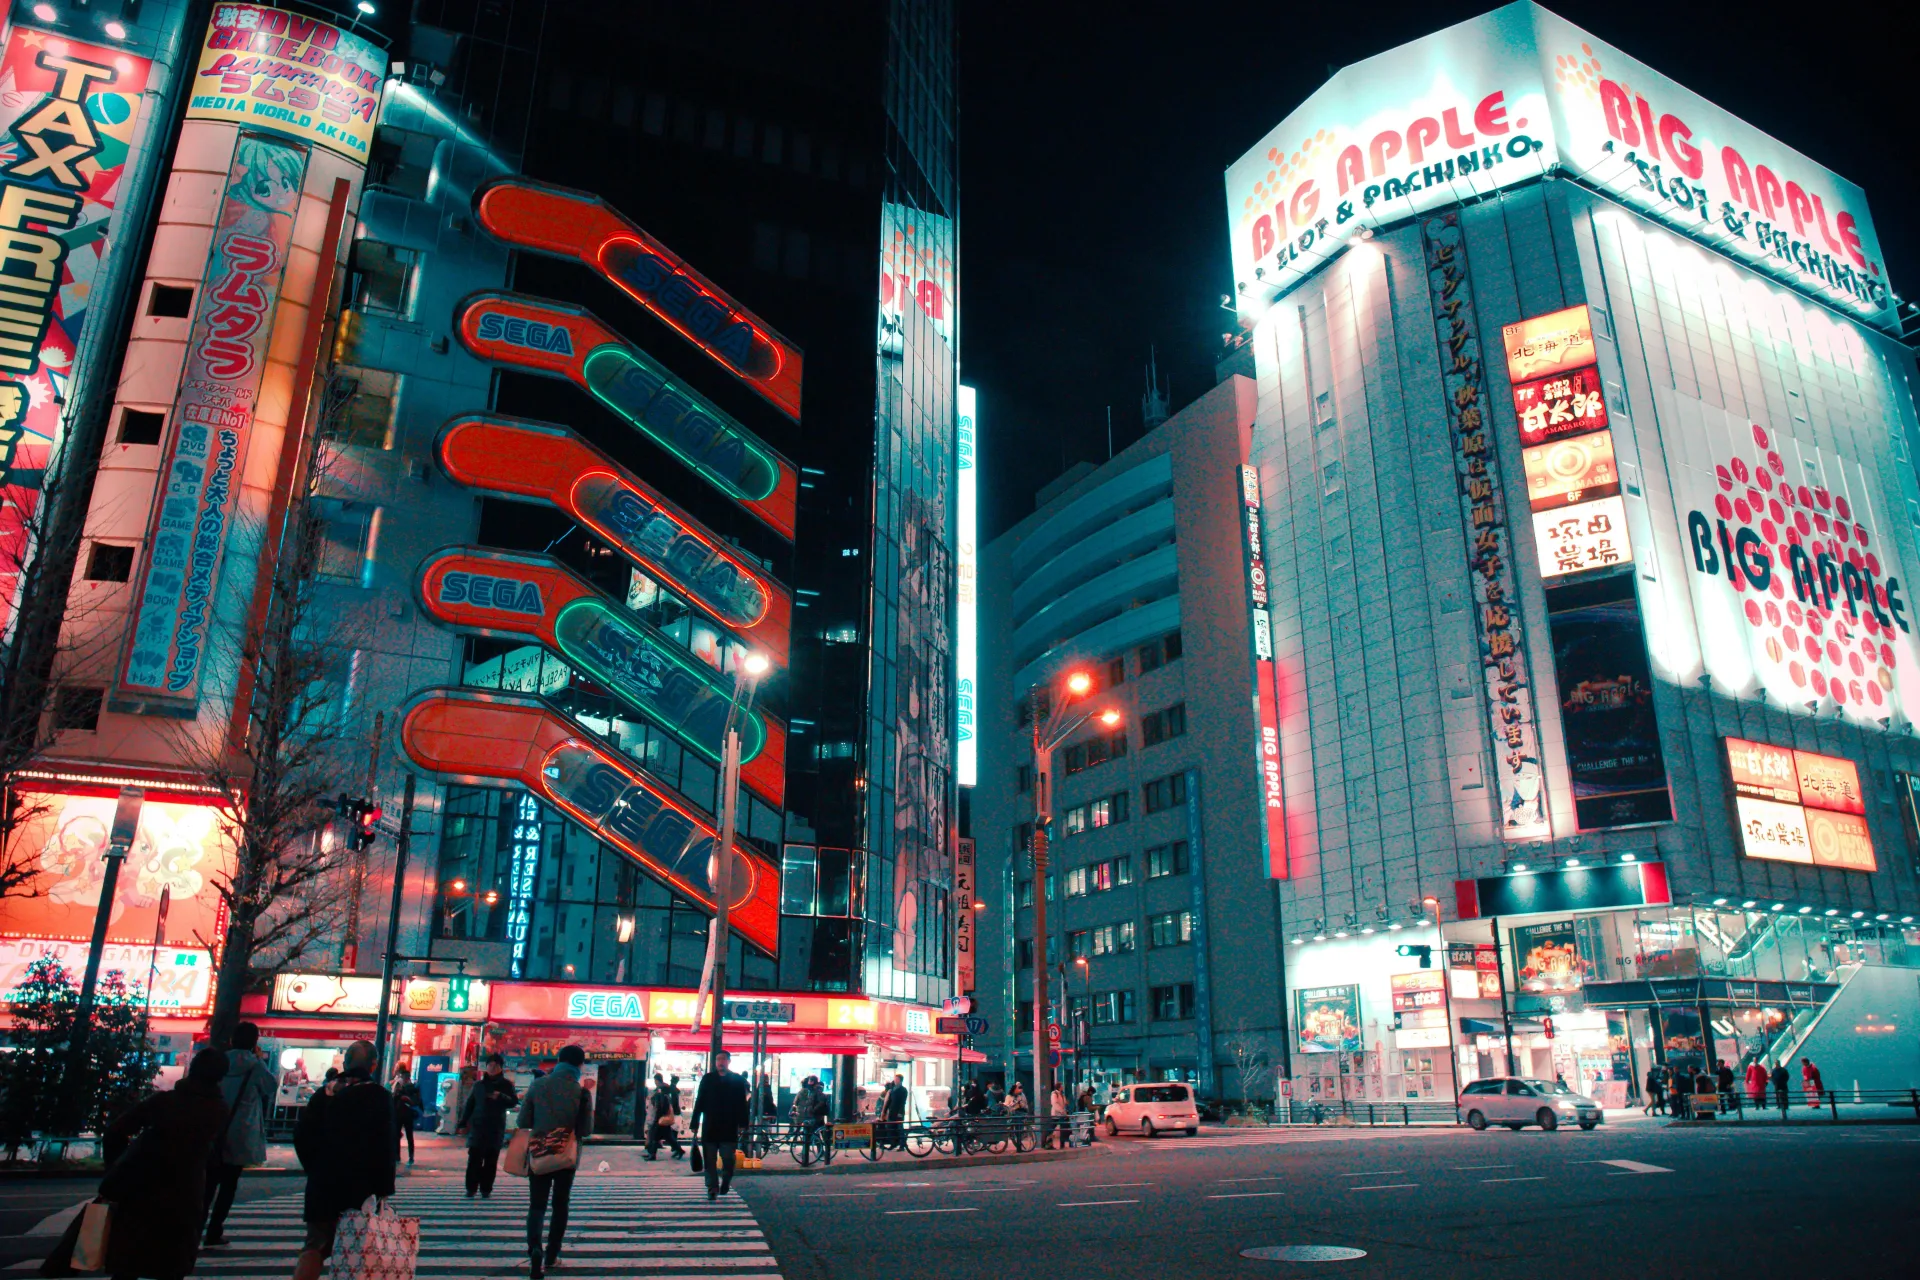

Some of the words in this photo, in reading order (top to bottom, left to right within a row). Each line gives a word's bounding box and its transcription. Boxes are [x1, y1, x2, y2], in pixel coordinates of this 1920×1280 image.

[259, 8, 340, 51] DVD
[220, 72, 352, 123] ラムタラ
[9, 56, 112, 187] TAX
[190, 96, 246, 112] MEDIA
[252, 101, 312, 128] WORLD
[315, 123, 367, 152] AKIBA
[1599, 79, 1704, 180] BIG
[1277, 217, 1330, 271] SLOT
[1335, 200, 1356, 225] &
[1363, 134, 1534, 208] PACHINKO
[1251, 179, 1320, 262] BIG
[1636, 159, 1713, 225] SLOT
[1721, 202, 1749, 241] &
[1756, 221, 1888, 311] PACHINKO
[197, 233, 278, 381] ラムタラ
[478, 312, 575, 357] SEGA
[1513, 333, 1585, 360] 北海道
[187, 380, 253, 399] メディアワールド
[202, 394, 231, 407] アキバ
[1517, 388, 1535, 400] 7F
[1519, 391, 1603, 433] 甘太郎
[959, 415, 973, 470] SEGA
[1545, 421, 1586, 435] AMATARO
[180, 440, 206, 451] DVD
[1567, 491, 1582, 502] 6F
[162, 518, 193, 531] GAME
[153, 556, 185, 569] GAME
[1688, 510, 1771, 591] BIG
[1789, 543, 1911, 634] APPLE
[145, 594, 177, 607] BOOK
[441, 573, 545, 616] SEGA
[958, 678, 973, 742] SEGA
[1263, 726, 1276, 756] BIG
[1577, 758, 1618, 773] CHALLENGE
[1747, 748, 1790, 781] 甘太郎
[1265, 759, 1281, 808] APPLE
[1803, 774, 1855, 800] 北海道
[1525, 924, 1552, 936] CHALLENGE
[104, 948, 168, 964] GAME
[1615, 956, 1632, 966] BIG
[568, 992, 642, 1019] SEGA
[968, 1020, 980, 1031] 17
